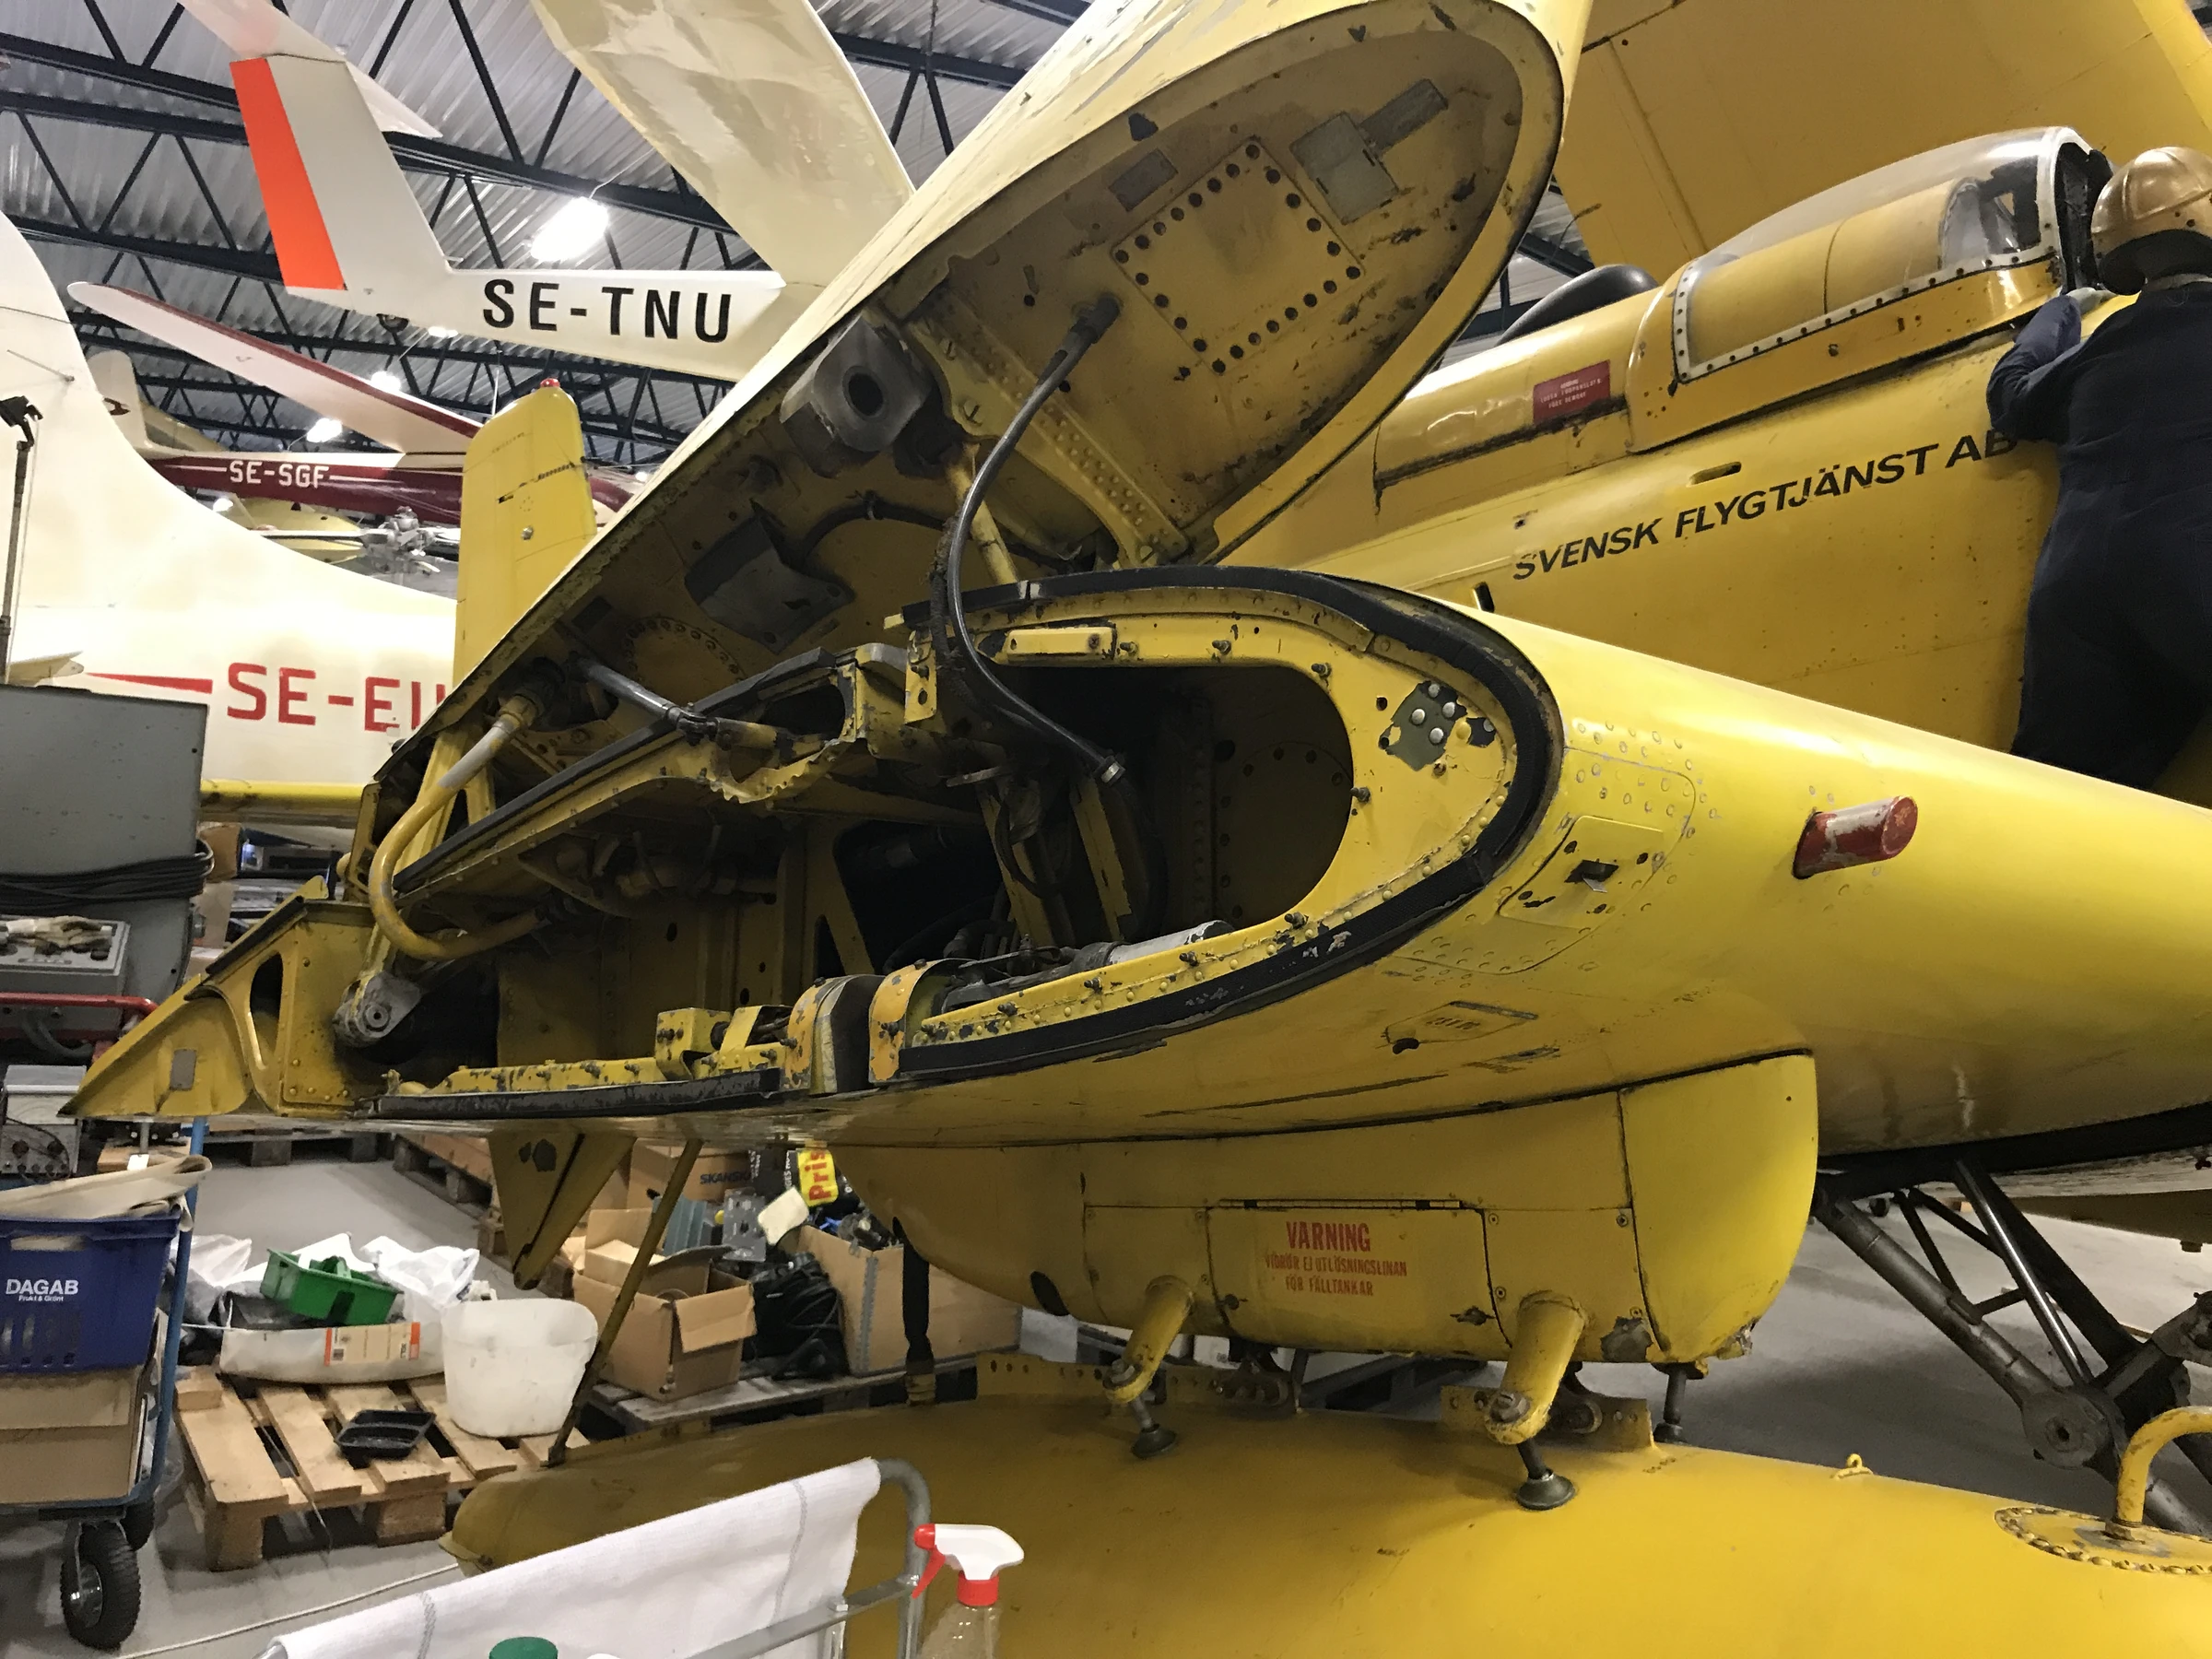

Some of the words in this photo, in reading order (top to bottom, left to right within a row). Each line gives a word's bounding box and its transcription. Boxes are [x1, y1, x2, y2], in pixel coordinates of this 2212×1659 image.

[483, 278, 732, 343] SE-TNU
[229, 460, 330, 488] SE-SGF
[1512, 518, 1663, 581] SVENSK
[1675, 443, 1939, 538] FLYGTJÄNST
[1945, 429, 2018, 468] AB
[1286, 1221, 1371, 1252] VARNING
[6, 1278, 79, 1295] DAGAB
